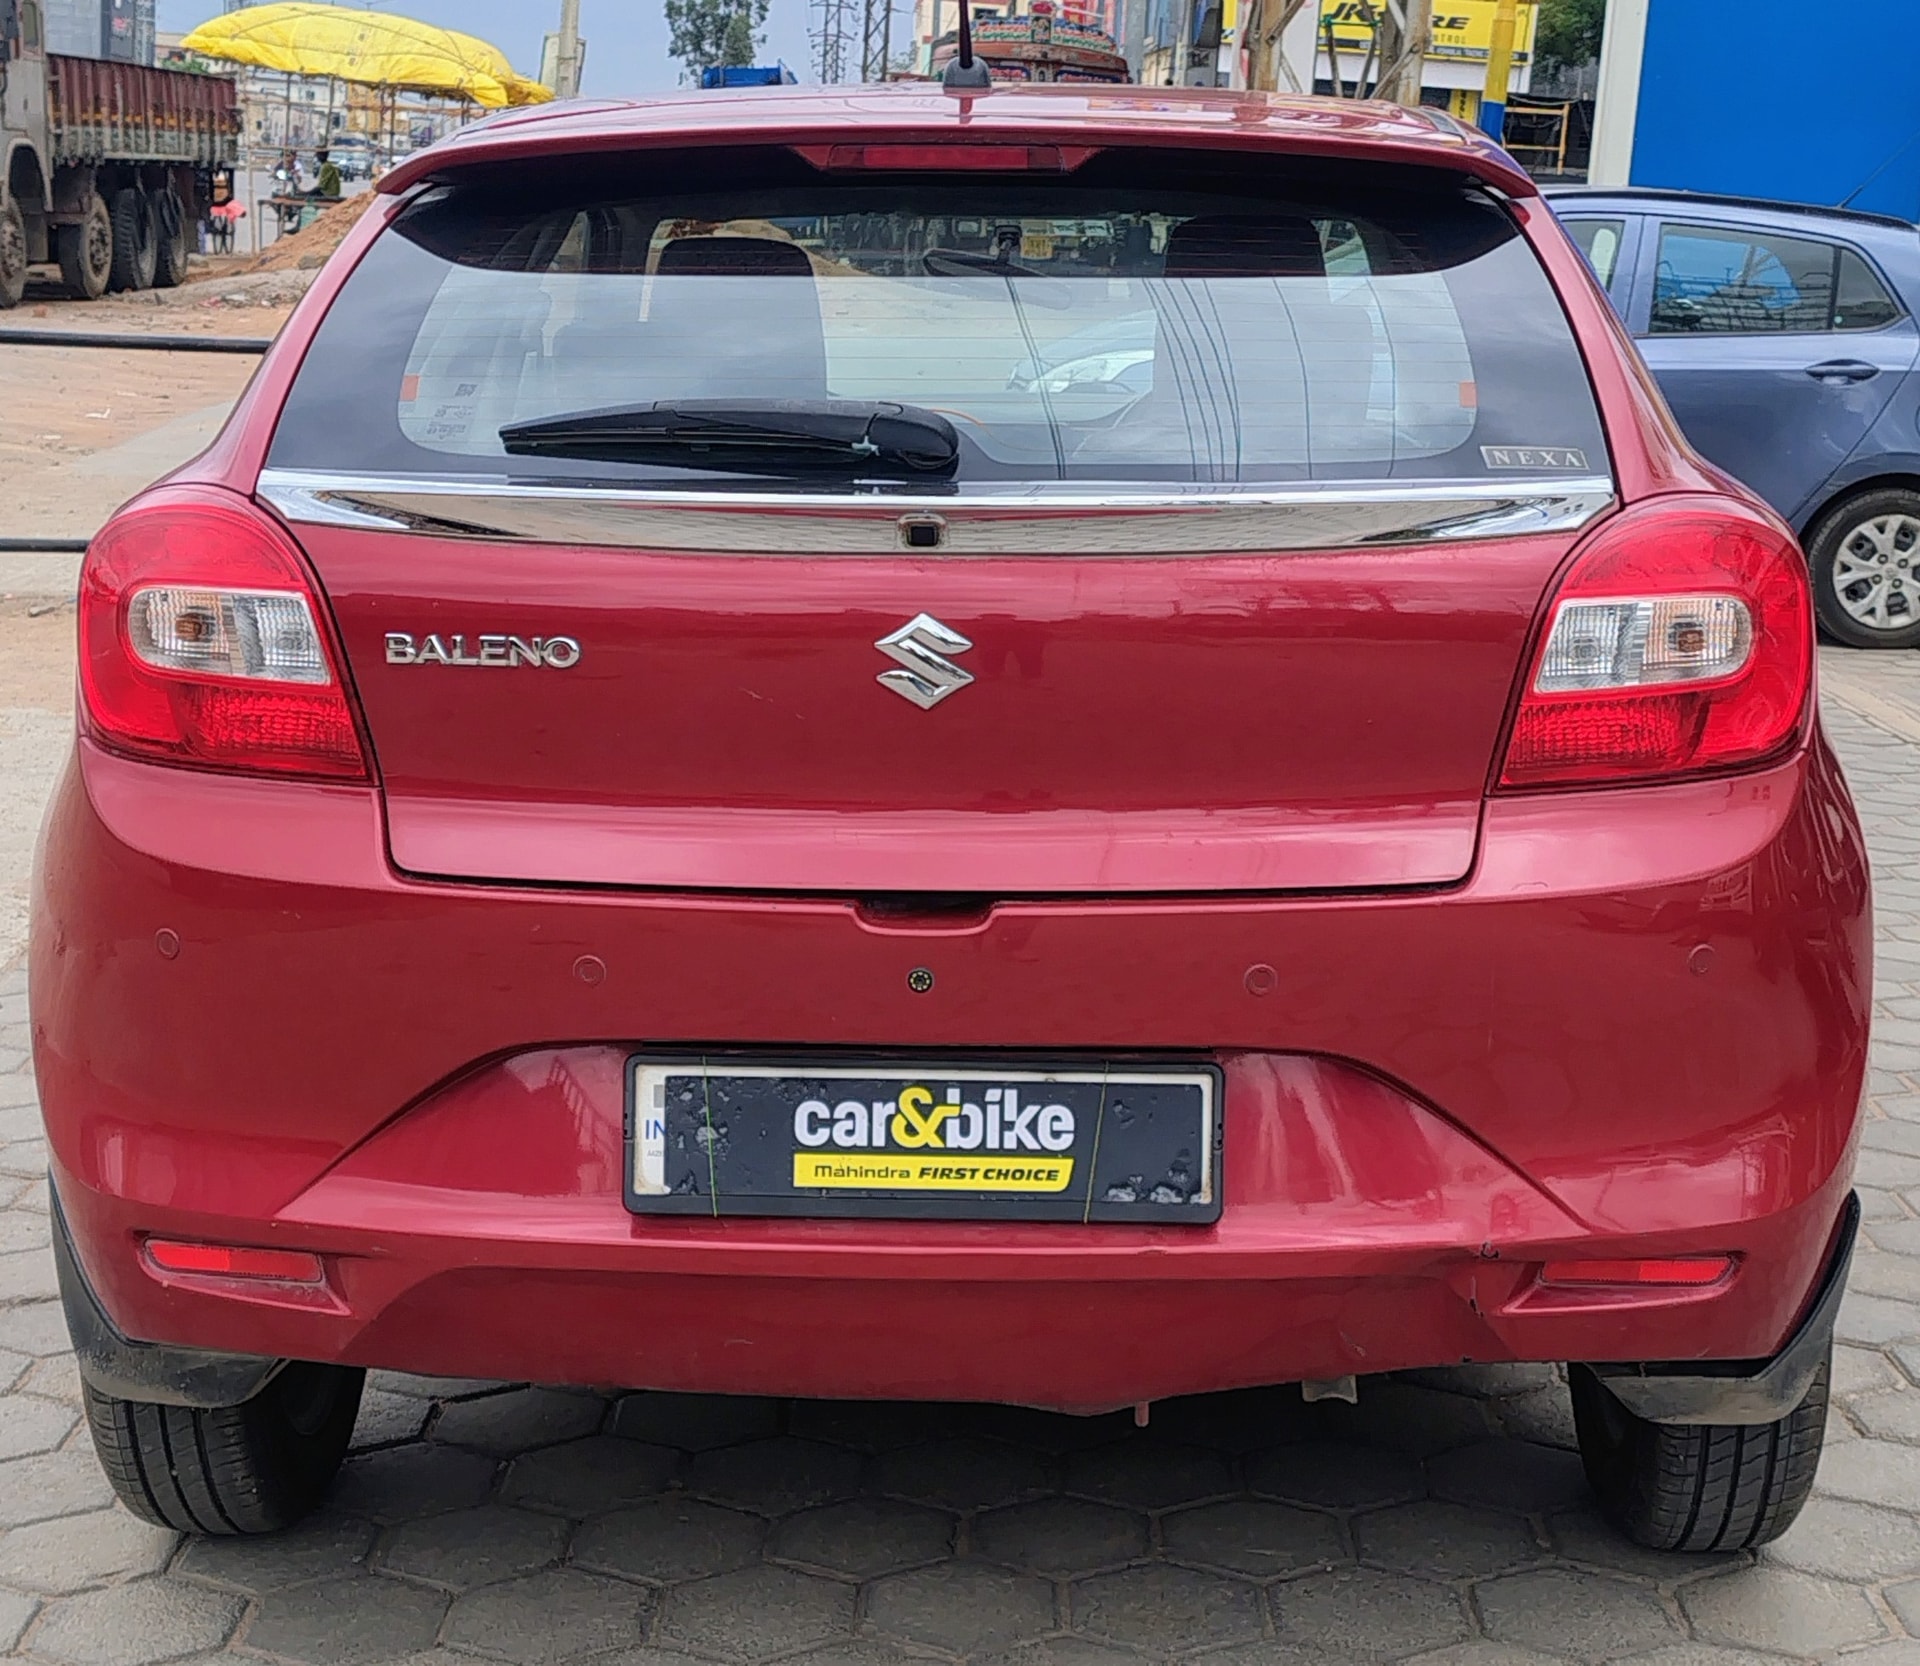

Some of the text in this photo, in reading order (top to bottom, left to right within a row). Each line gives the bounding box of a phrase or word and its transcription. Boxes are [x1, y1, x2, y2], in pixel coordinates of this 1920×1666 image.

[1492, 450, 1583, 467] NEXA
[385, 633, 580, 668] BALENO
[793, 1086, 1075, 1151] car&bike
[814, 1165, 1060, 1182] Mahindra FIRST CHOICE
